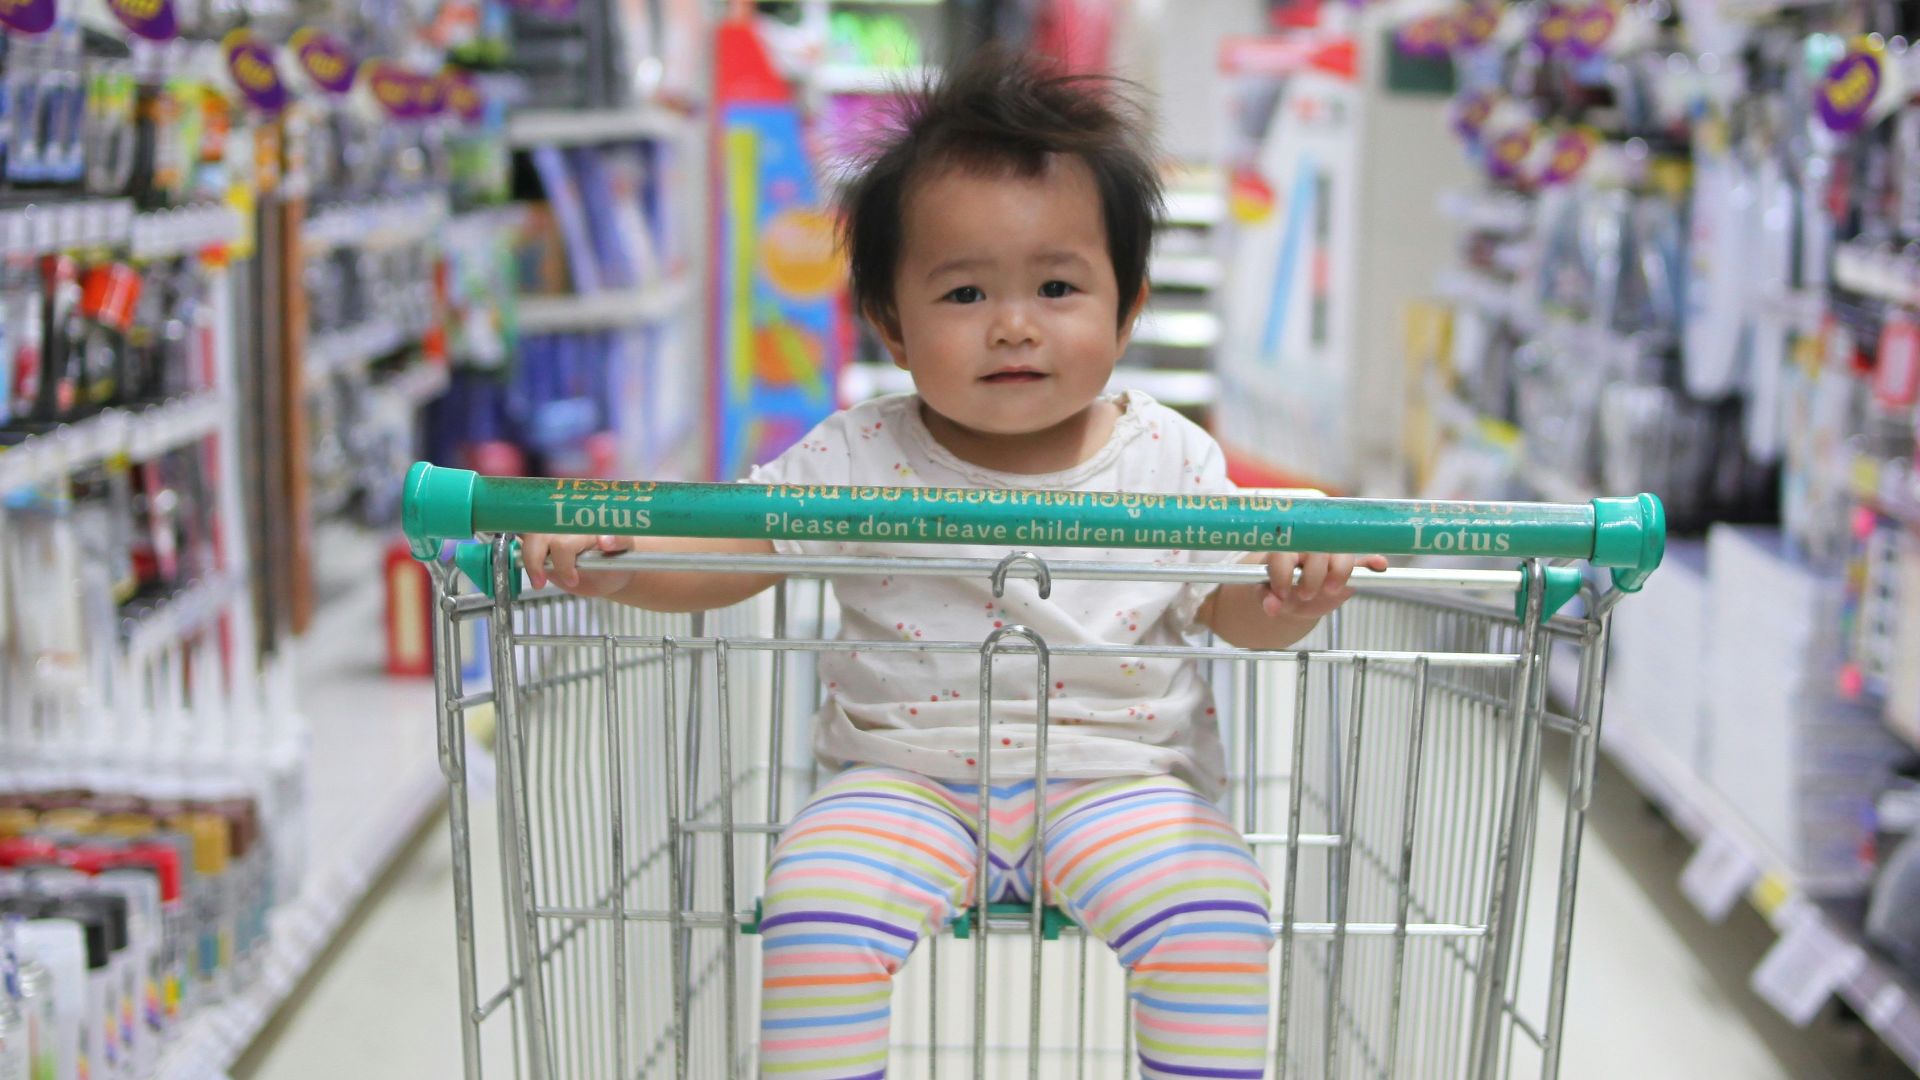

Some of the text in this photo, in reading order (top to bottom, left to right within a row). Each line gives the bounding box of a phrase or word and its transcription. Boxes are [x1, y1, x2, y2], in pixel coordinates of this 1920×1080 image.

[554, 501, 652, 528] Lotus
[765, 512, 1292, 546] Please don't leave children unattended
[1411, 523, 1510, 552] Lotus
